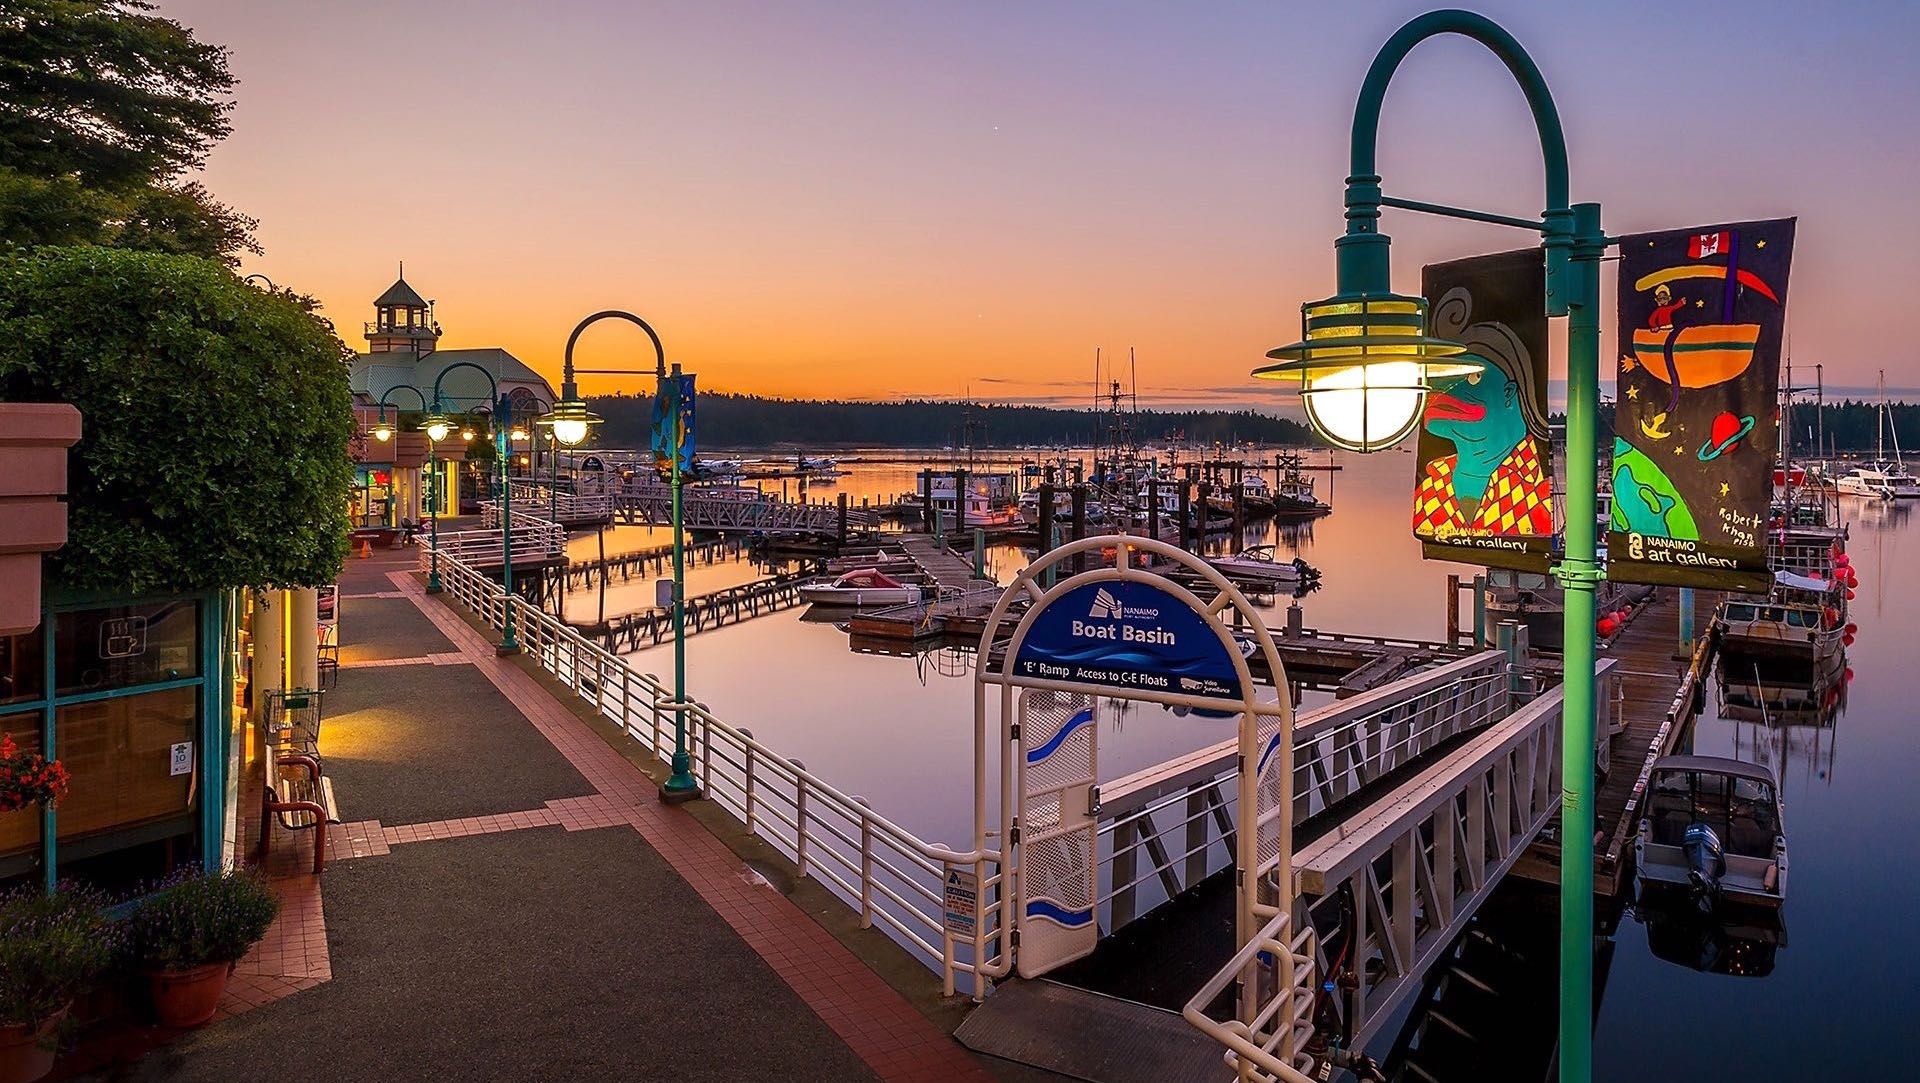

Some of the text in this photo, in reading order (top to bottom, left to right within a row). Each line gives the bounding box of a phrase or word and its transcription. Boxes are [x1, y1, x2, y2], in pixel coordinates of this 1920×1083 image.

[1719, 507, 1763, 529] Robert
[1452, 537, 1472, 547] art
[1647, 536, 1696, 552] NANAIMO
[1648, 548, 1737, 569] art gallery
[1123, 607, 1159, 617] NANAIMO
[1072, 620, 1176, 645] Boat Basin
[1039, 662, 1070, 679] Ramp
[1076, 667, 1107, 681] Access
[1108, 671, 1119, 682] to
[1121, 671, 1137, 684] C-E
[1140, 673, 1169, 688] Floats
